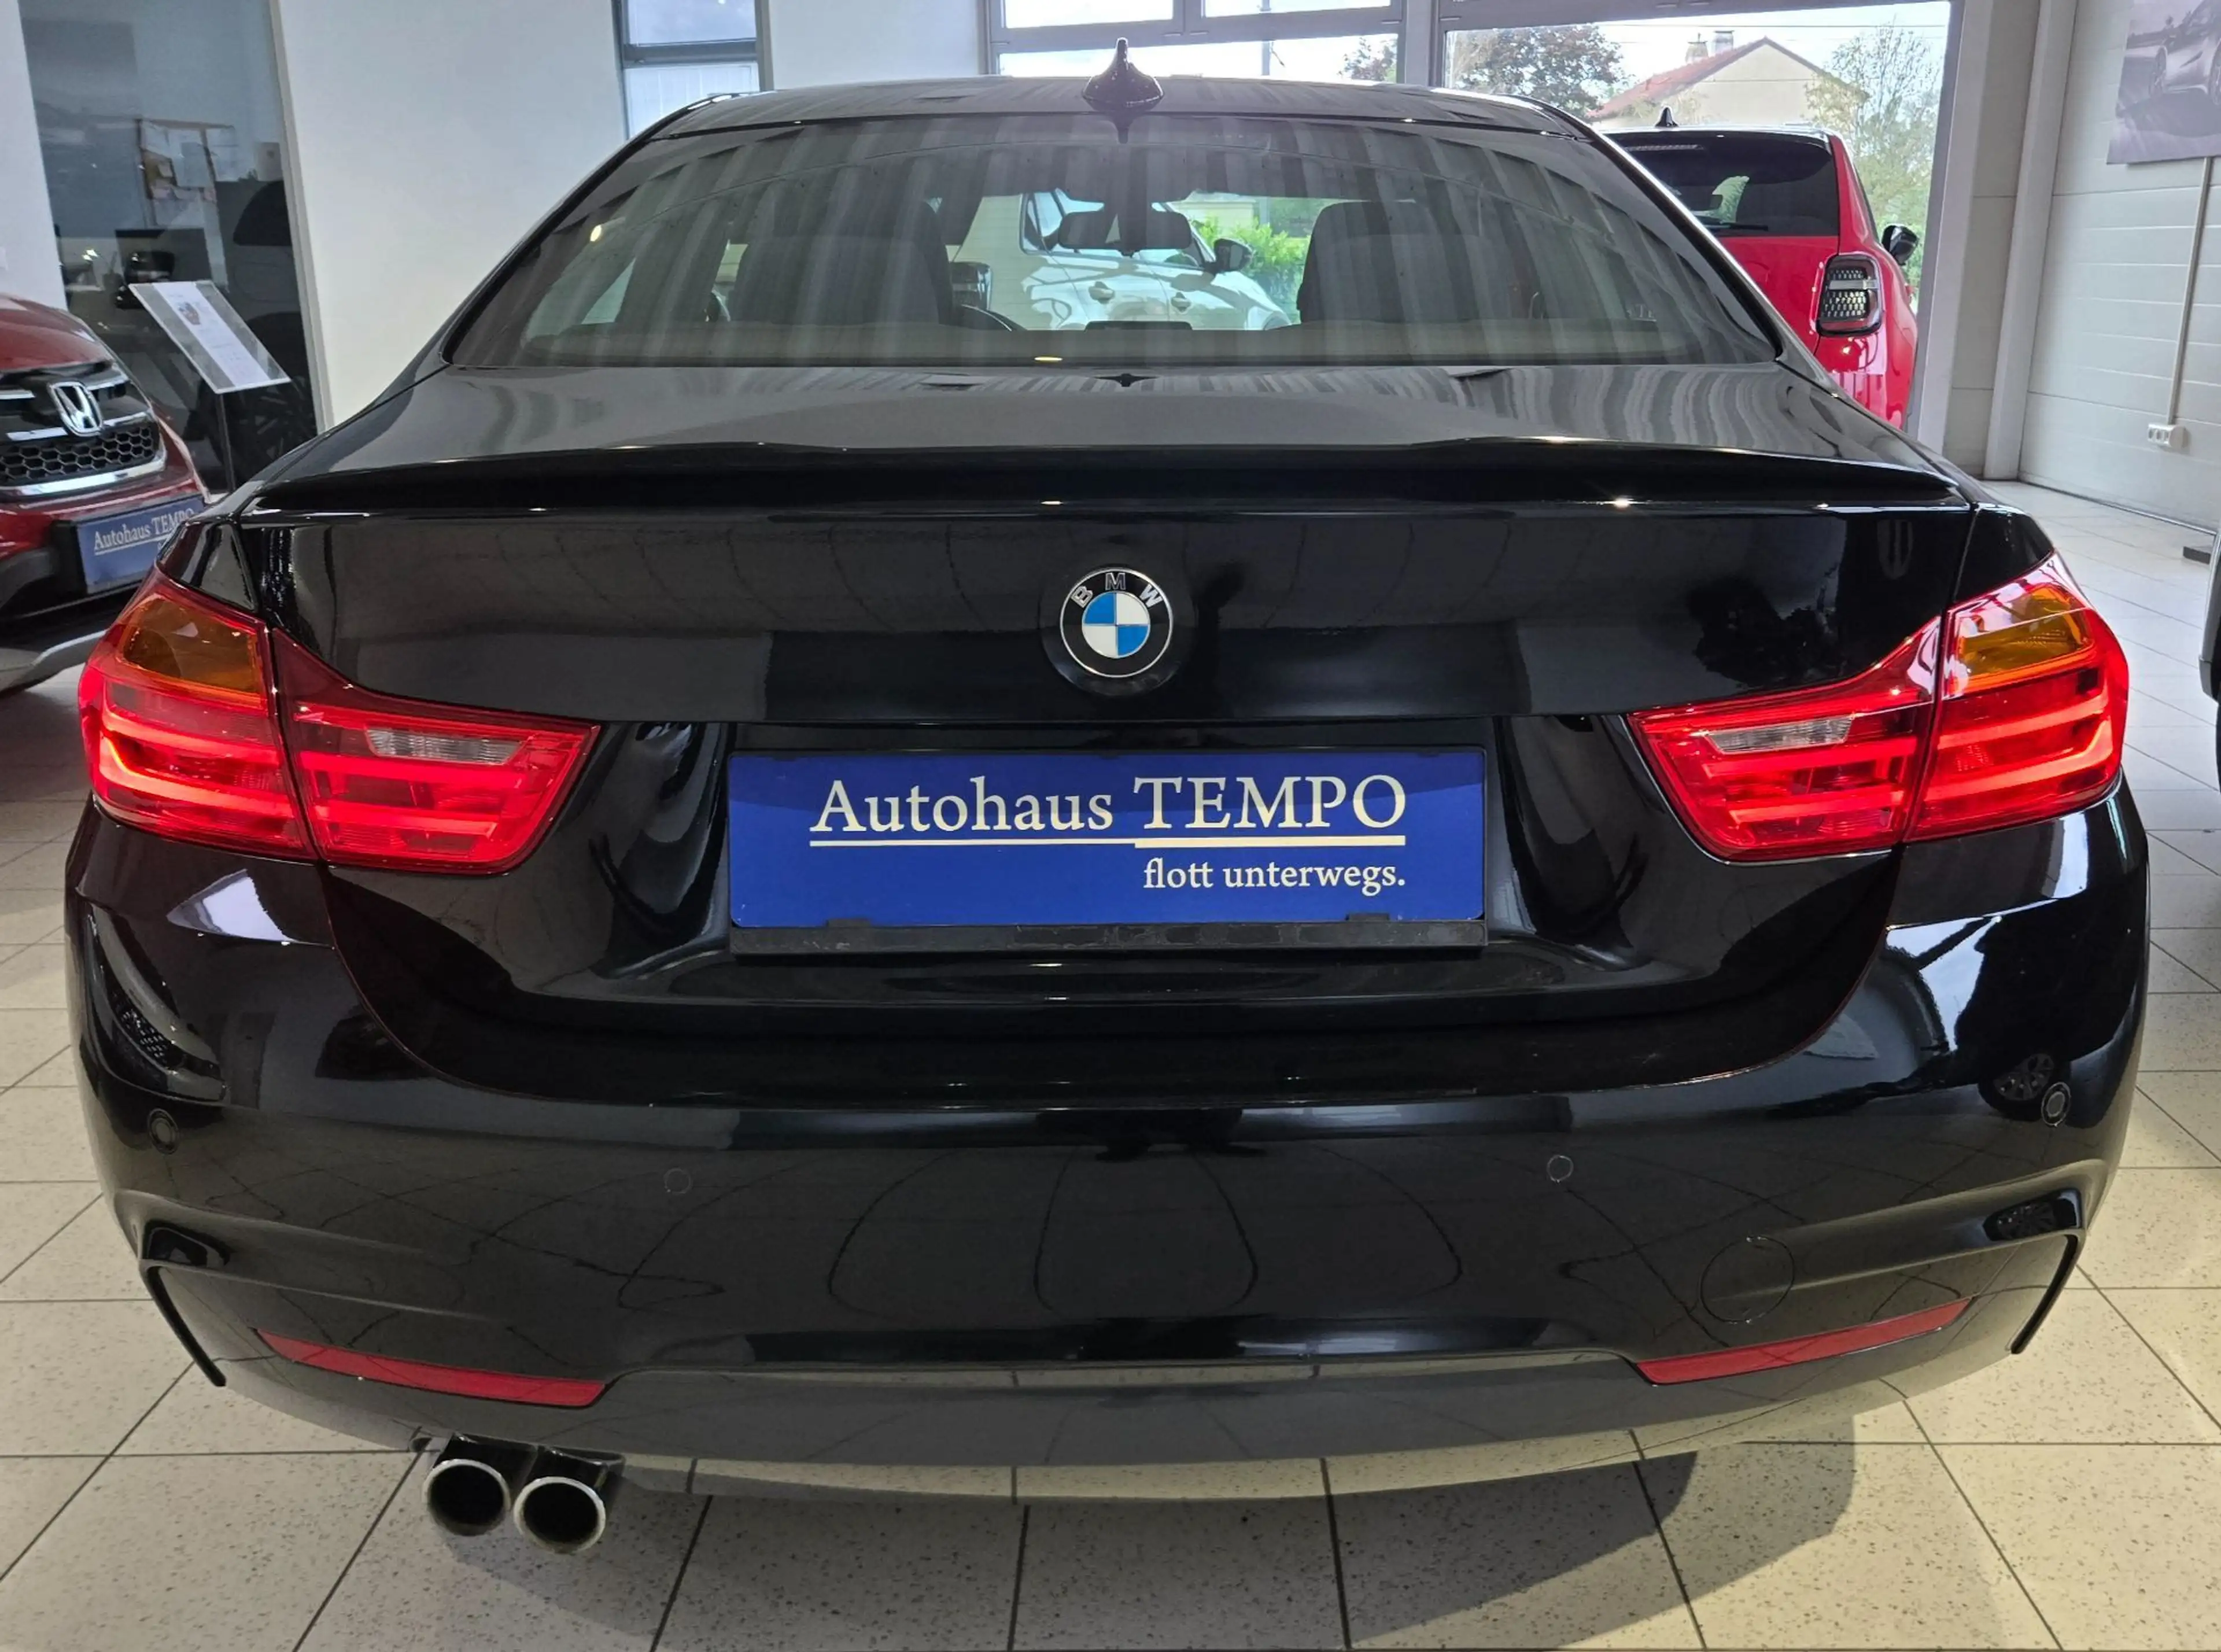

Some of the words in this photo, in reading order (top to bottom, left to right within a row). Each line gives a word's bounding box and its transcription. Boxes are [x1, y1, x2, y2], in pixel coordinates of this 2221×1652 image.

[94, 523, 150, 550] Autohaus
[1071, 573, 1163, 608] BMW
[809, 775, 1113, 832] Autohaus
[1134, 775, 1405, 828] TEMPO
[1143, 857, 1214, 888] flott
[1222, 862, 1405, 897] unterwegs.
